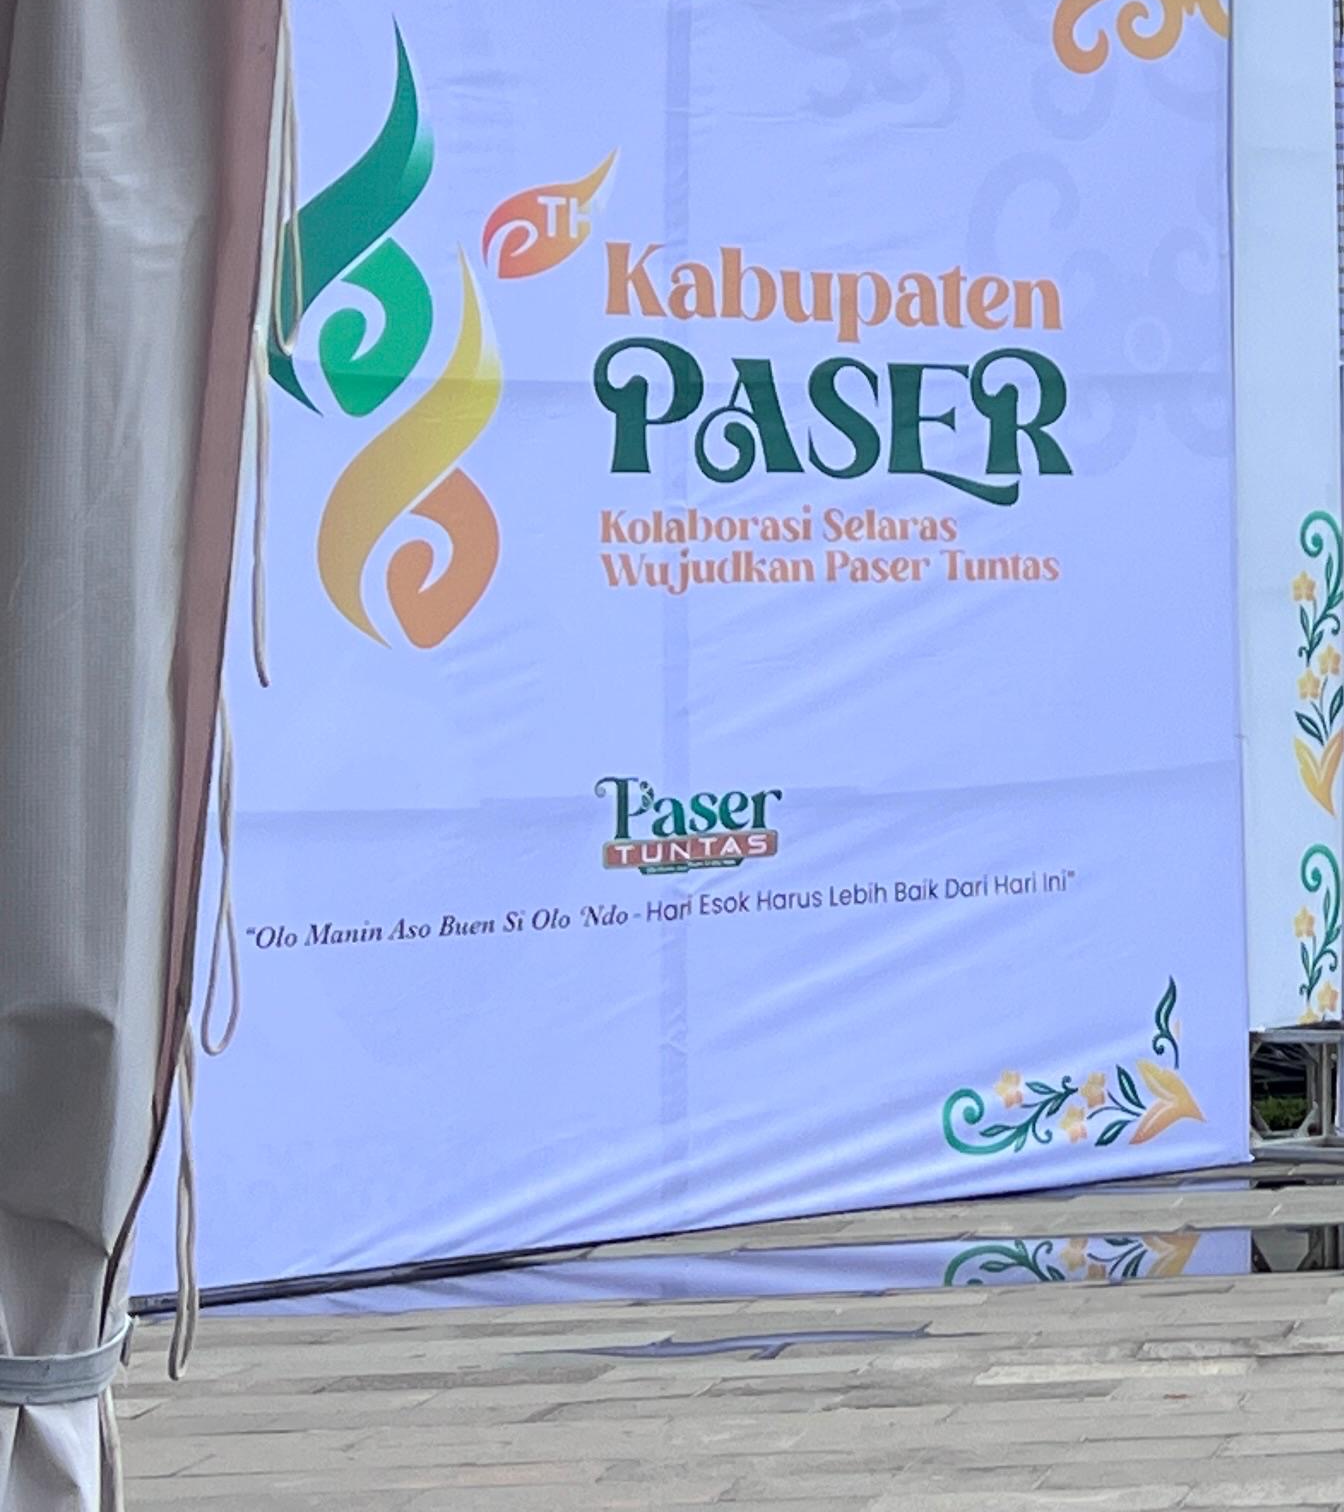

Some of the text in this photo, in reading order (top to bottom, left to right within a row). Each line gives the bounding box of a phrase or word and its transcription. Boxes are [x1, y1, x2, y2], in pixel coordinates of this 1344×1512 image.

[604, 241, 1063, 344] Kabupaten
[593, 336, 1074, 507] PASER
[599, 505, 958, 545] Kolaborasi Selaras
[599, 548, 1061, 595] Wujudkan Paser Tuntas
[594, 776, 783, 840] Paser
[614, 833, 769, 865] TUNTAS
[304, 919, 384, 947] Manin
[387, 918, 432, 941] Aso
[438, 914, 496, 937] Buen
[502, 909, 525, 933] Si
[531, 907, 571, 931] Olo
[646, 899, 692, 923] Hari
[700, 889, 750, 916] Esok
[757, 889, 823, 912] Harus
[829, 883, 888, 907] Lebih
[897, 876, 940, 902] Baik
[944, 873, 988, 899] Dari
[994, 870, 1037, 896] Hari
